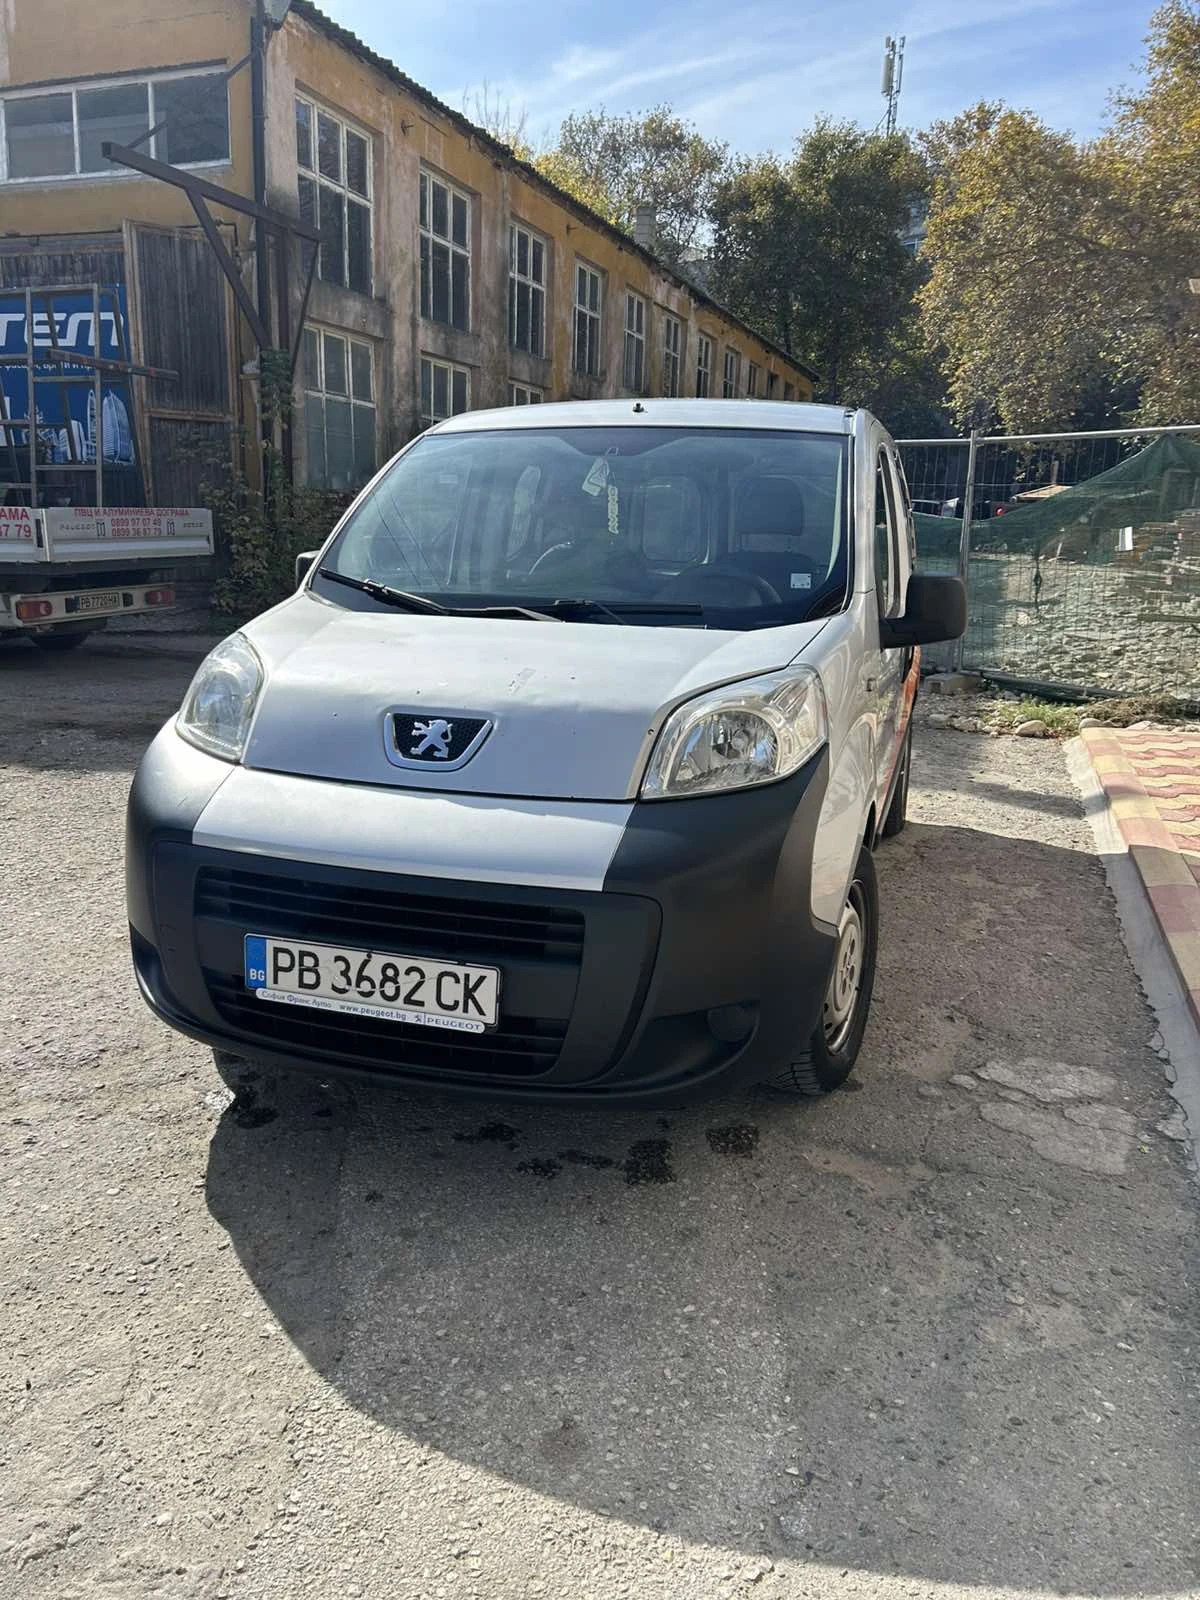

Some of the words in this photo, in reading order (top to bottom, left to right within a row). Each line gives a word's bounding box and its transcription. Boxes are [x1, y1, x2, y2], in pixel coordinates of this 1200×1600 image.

[103, 507, 155, 517] АЛУМИНИЕВА
[0, 524, 10, 537] 7
[15, 524, 32, 538] 79
[249, 968, 265, 981] BG
[331, 955, 425, 1007] 3682
[339, 1004, 407, 1020] www.peugeot.bg
[427, 1017, 481, 1031] PEUGEOT
